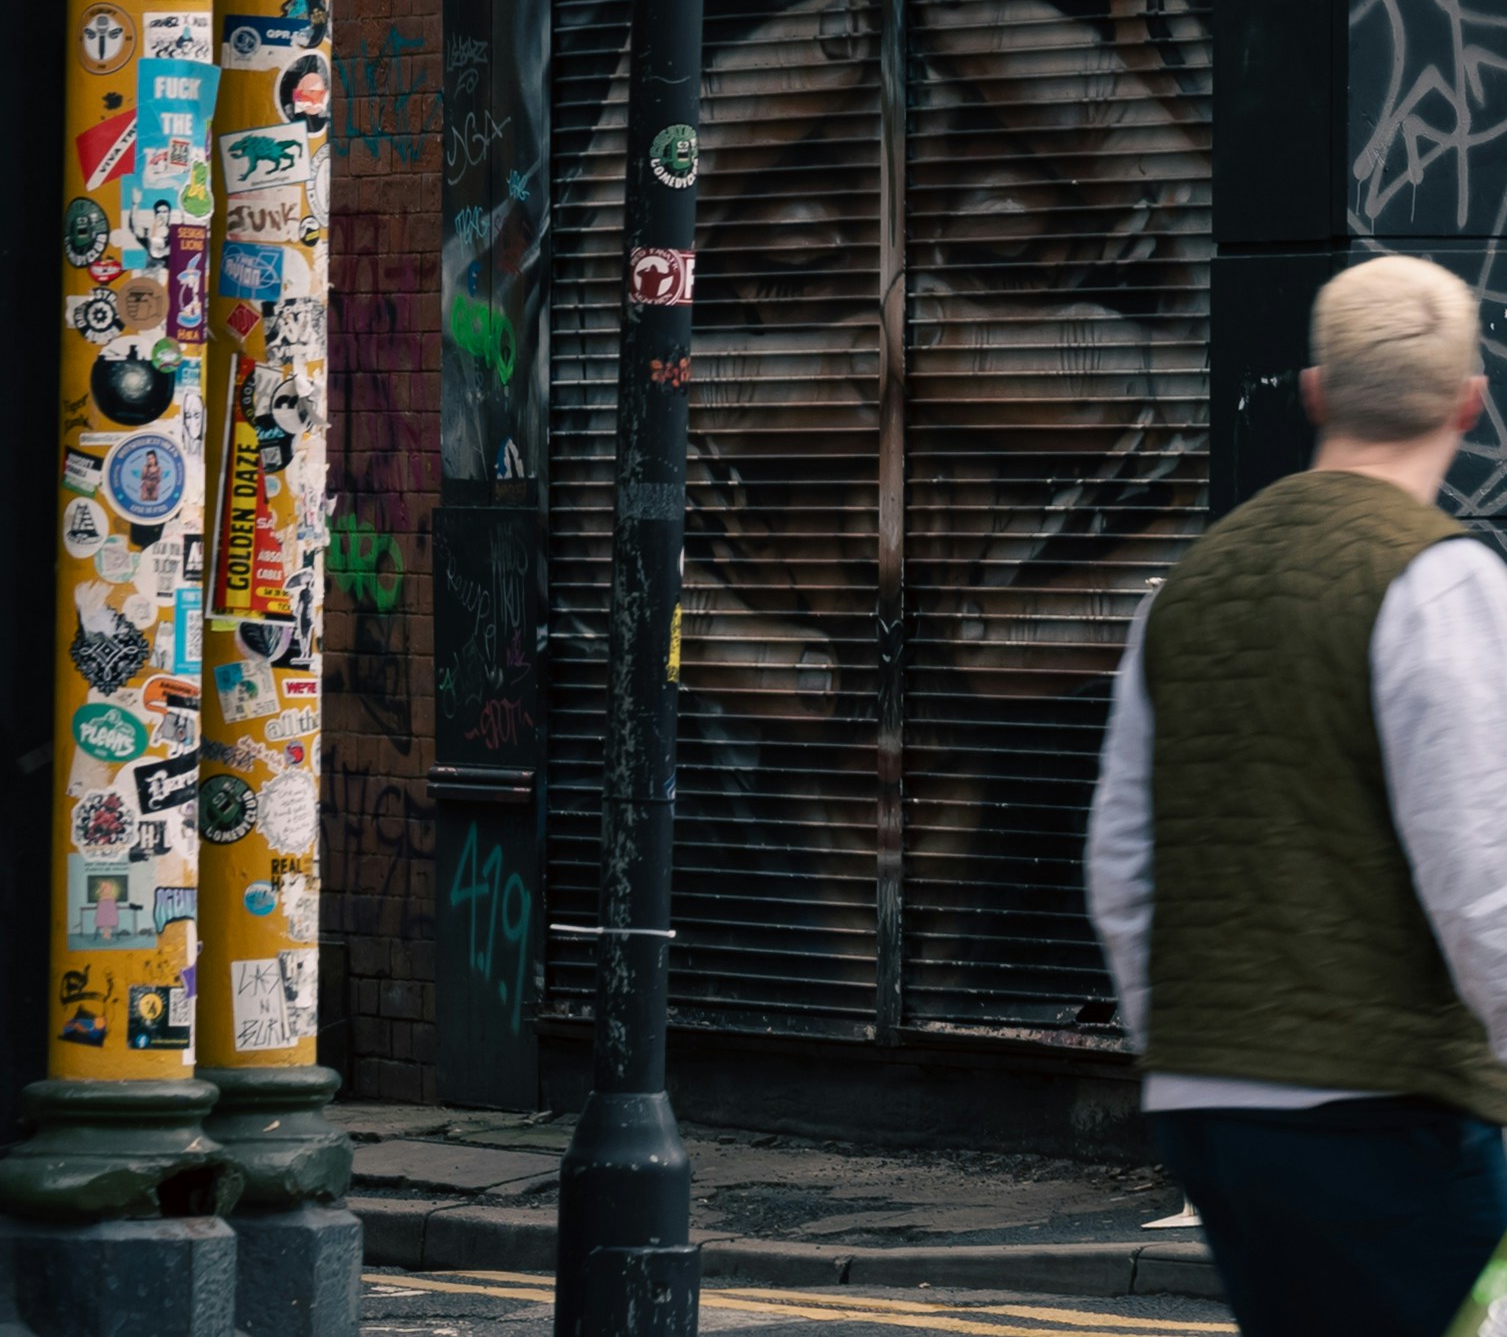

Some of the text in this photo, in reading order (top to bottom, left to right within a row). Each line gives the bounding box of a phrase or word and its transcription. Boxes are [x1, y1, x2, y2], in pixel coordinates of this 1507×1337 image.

[154, 76, 202, 100] FUCK
[160, 112, 194, 135] THE
[99, 147, 122, 173] VIVA
[227, 442, 259, 592] GOLDEN DAZE
[270, 858, 303, 874] REAL
